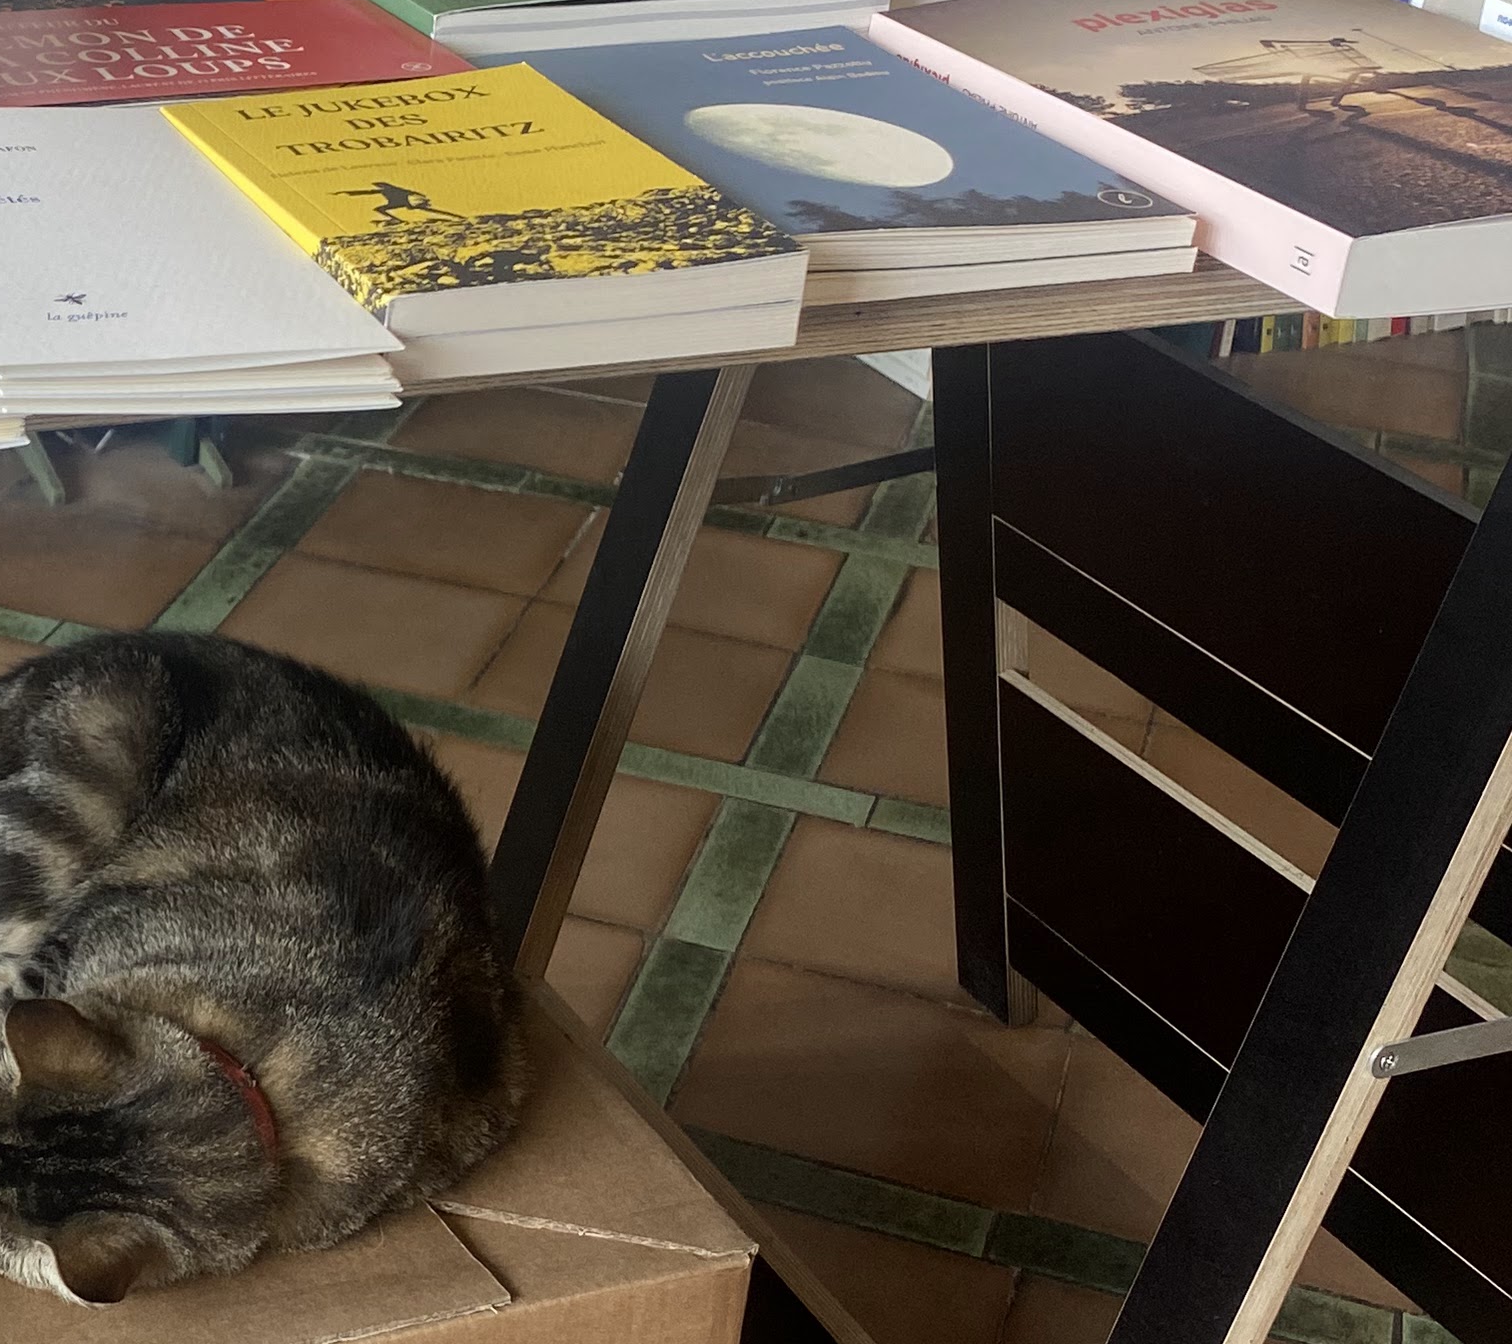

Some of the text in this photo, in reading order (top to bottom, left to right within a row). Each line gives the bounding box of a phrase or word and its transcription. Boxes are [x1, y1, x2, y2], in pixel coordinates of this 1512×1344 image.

[166, 23, 255, 42] DE
[1136, 22, 1205, 38] ANTOINE
[36, 36, 306, 66] COLLINE
[702, 42, 846, 63] L'accouchée
[91, 56, 293, 81] LOUPS
[235, 83, 491, 121] LE JUKEBOX
[343, 112, 430, 132] DES
[274, 119, 545, 158] TROBAIRITZ
